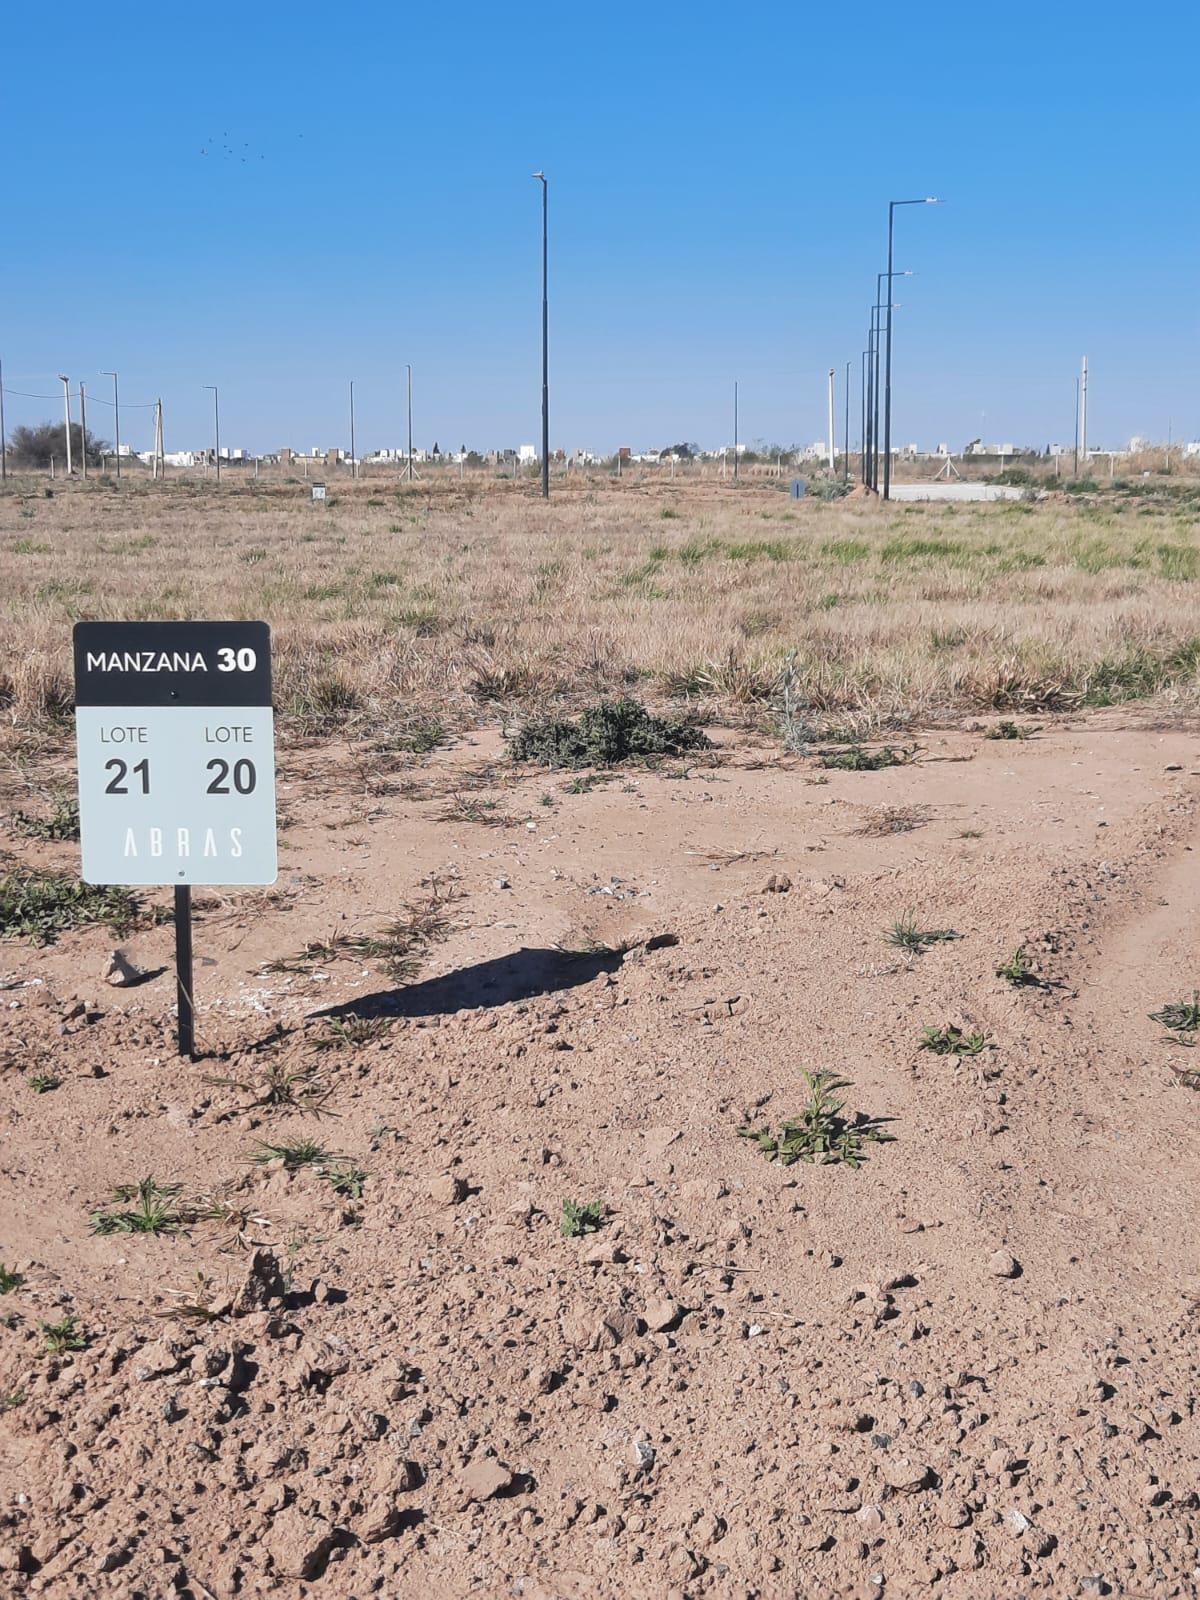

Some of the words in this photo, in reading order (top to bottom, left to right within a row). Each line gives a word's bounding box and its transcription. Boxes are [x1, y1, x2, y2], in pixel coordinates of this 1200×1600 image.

[87, 652, 208, 672] MANZANA
[217, 648, 257, 672] 30
[100, 727, 148, 743] LOTE
[205, 726, 253, 743] LOTE
[104, 758, 151, 795] 21
[206, 758, 257, 795] 20
[124, 827, 243, 857] ABRAS
